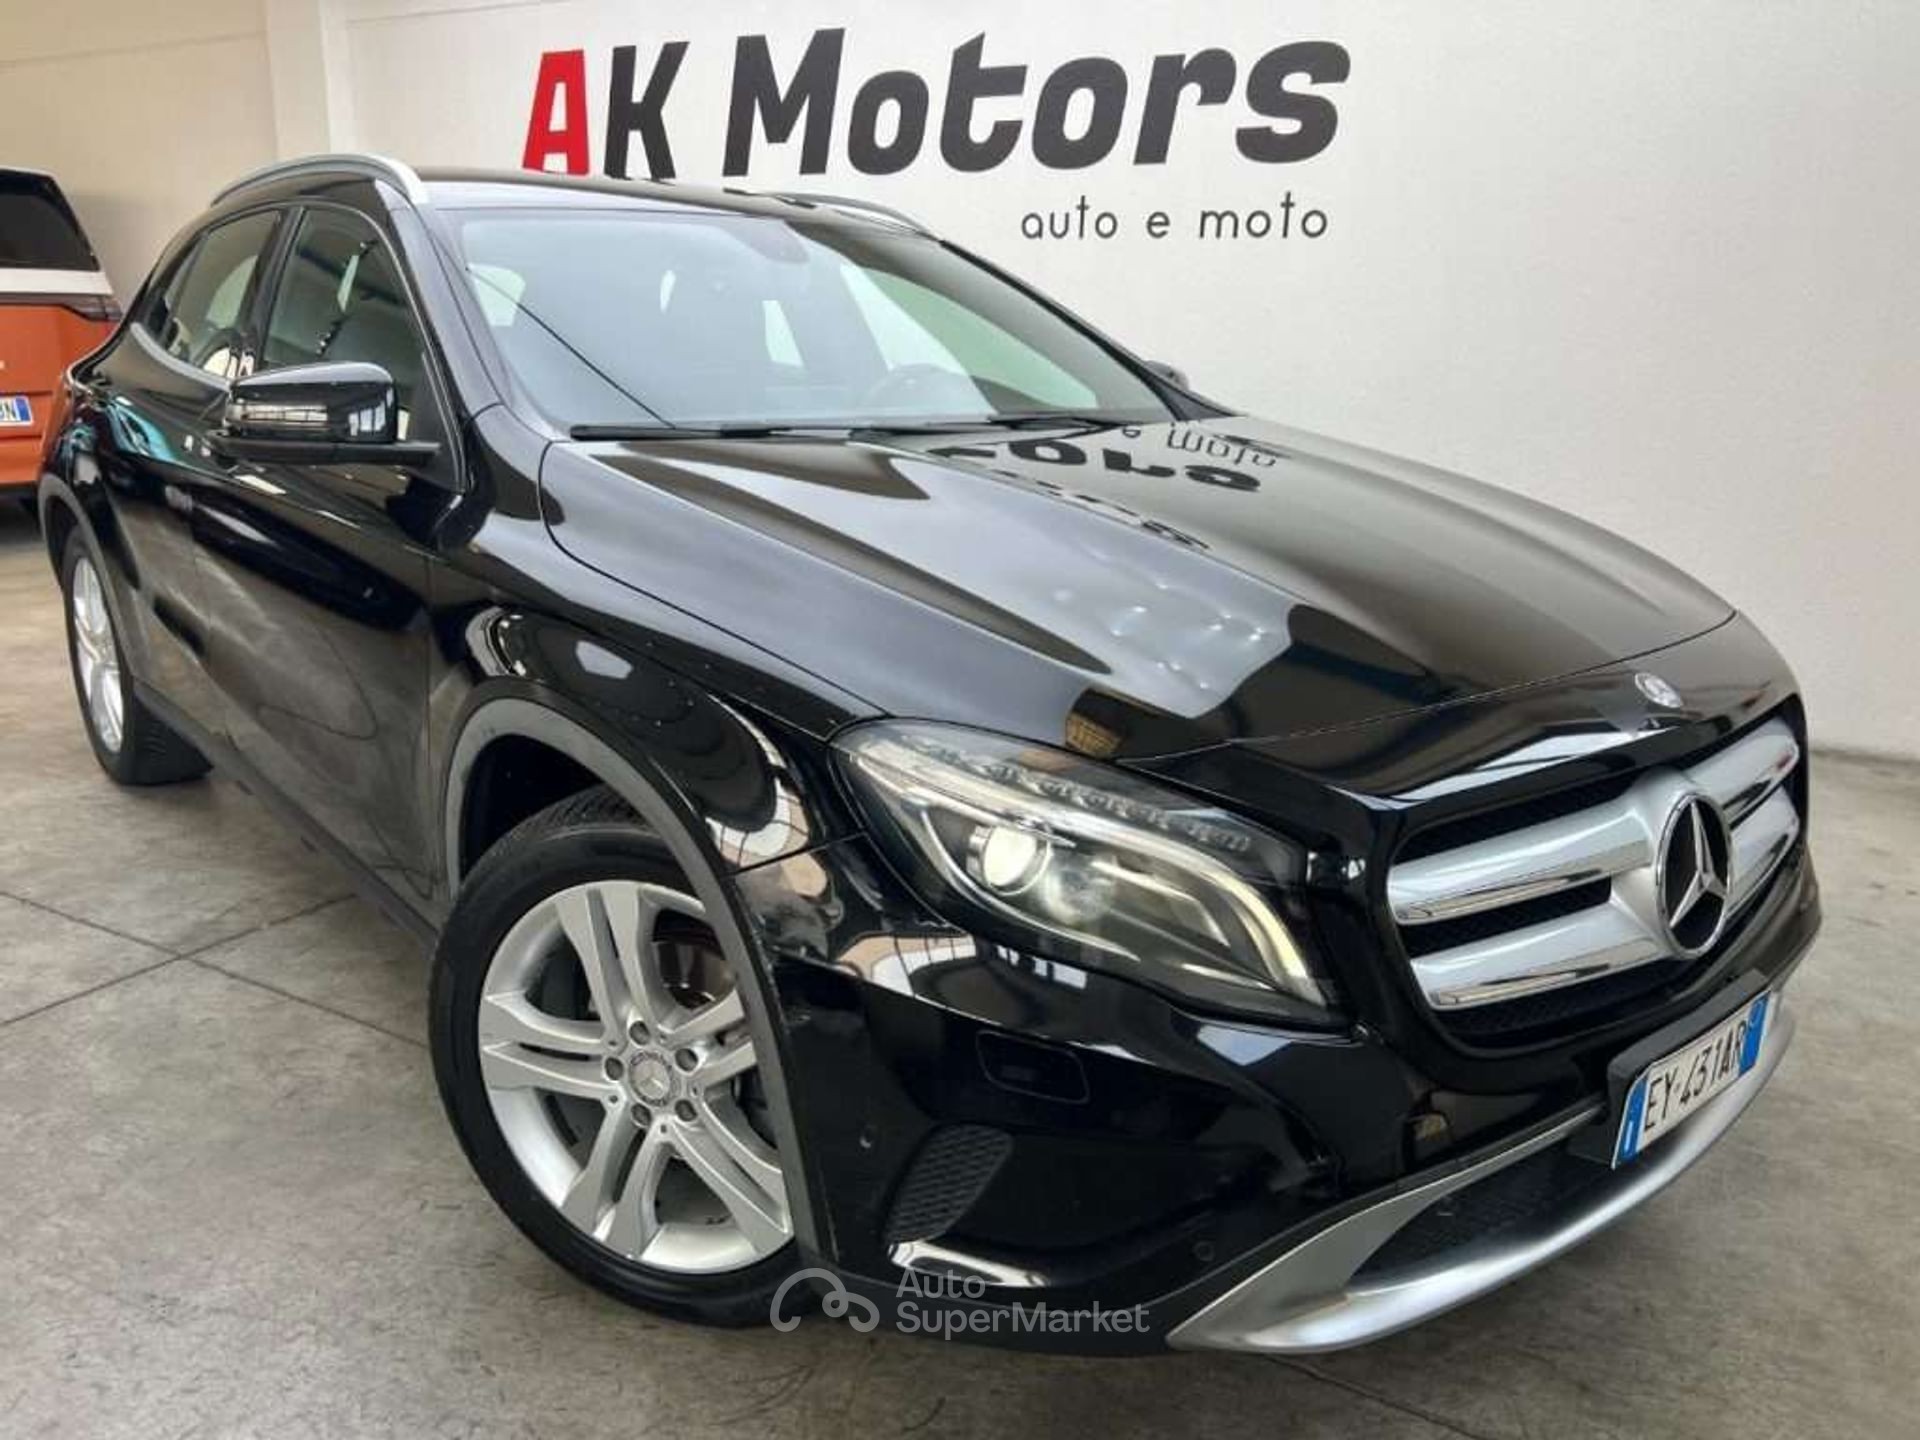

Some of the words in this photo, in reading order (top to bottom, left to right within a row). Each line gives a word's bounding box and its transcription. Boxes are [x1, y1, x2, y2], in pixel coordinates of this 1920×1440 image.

[523, 42, 690, 178] AK
[722, 27, 1352, 176] Motors
[1021, 196, 1119, 239] auto
[1147, 215, 1169, 239] e
[1199, 192, 1328, 239] moto
